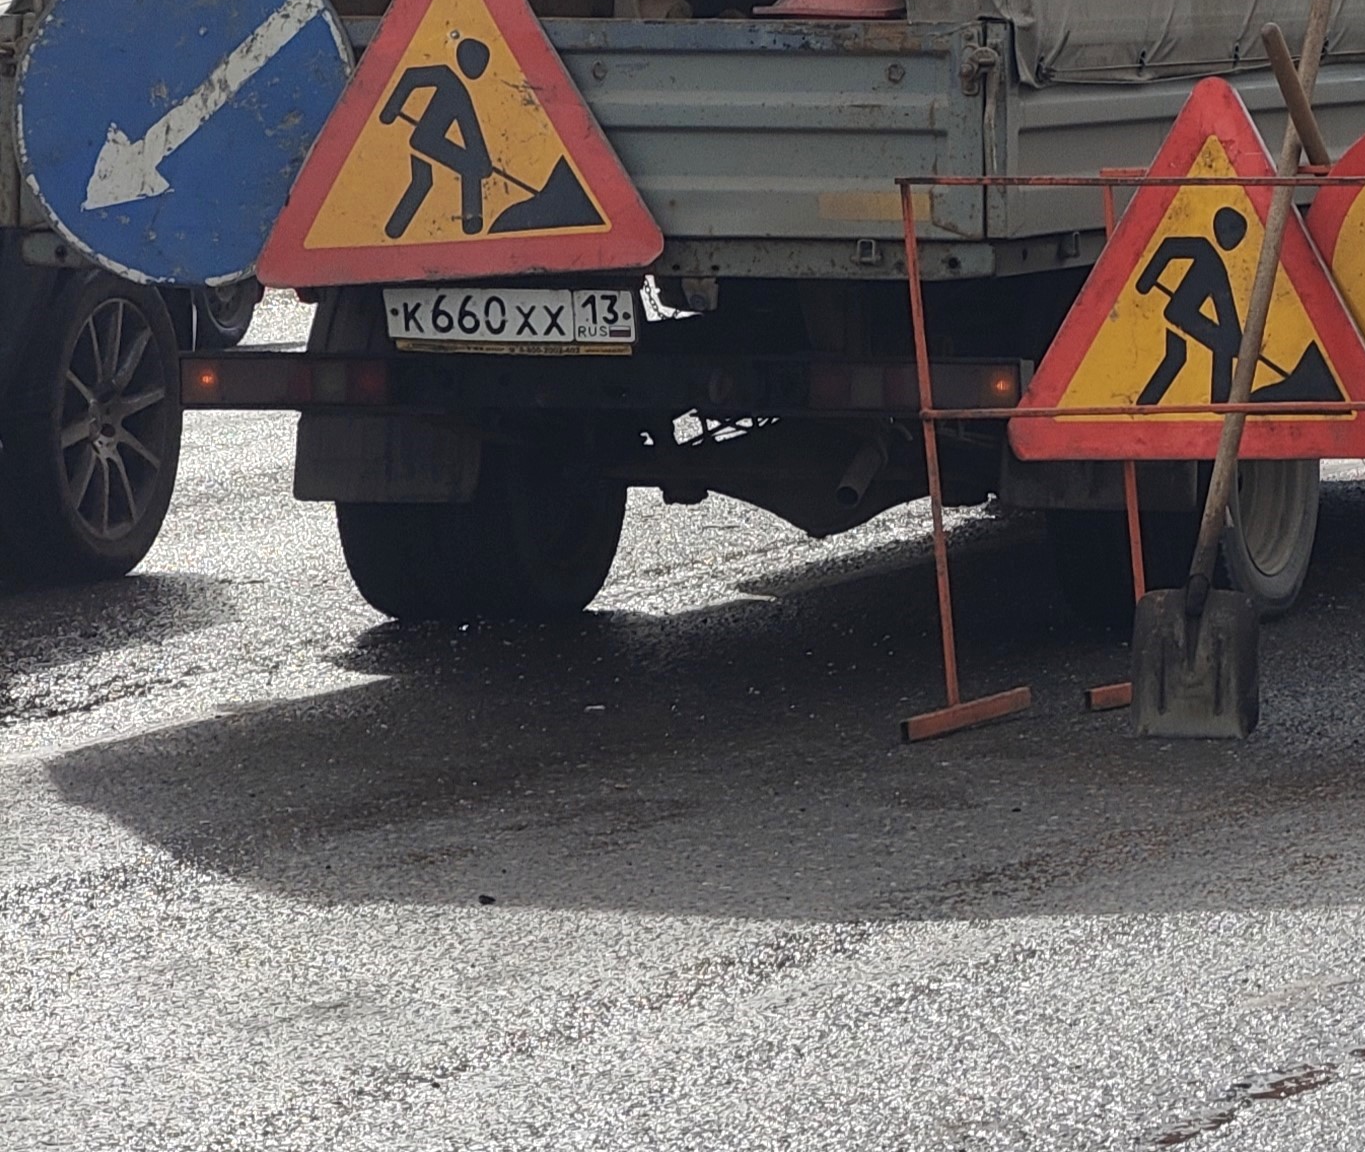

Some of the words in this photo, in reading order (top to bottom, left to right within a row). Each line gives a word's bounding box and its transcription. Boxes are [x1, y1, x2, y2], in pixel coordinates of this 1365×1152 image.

[403, 295, 566, 336] К660ХХ
[581, 294, 619, 325] 13
[577, 325, 608, 338] RUS
